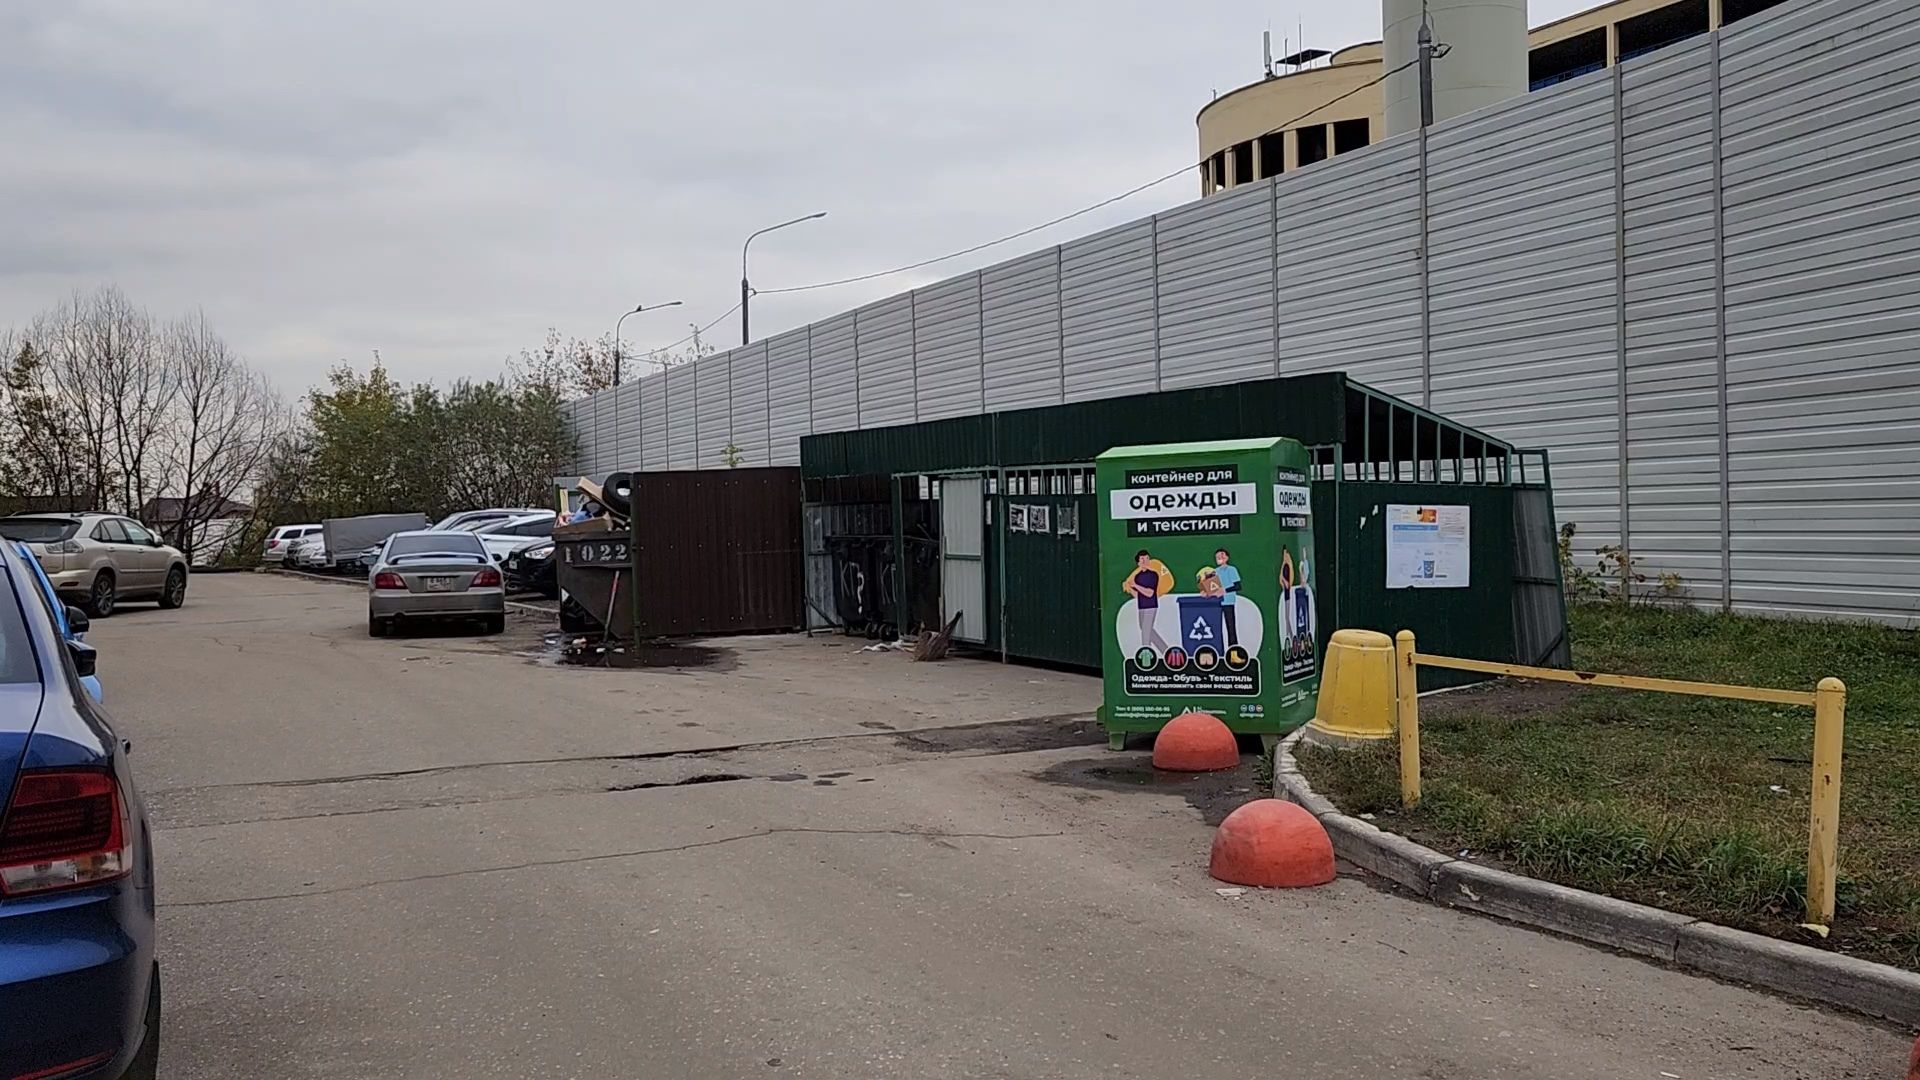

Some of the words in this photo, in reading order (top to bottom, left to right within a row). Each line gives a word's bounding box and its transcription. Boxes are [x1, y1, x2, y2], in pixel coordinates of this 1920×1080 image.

[1131, 471, 1204, 484] контейнер
[1206, 469, 1233, 481] для
[1129, 491, 1237, 511] одежды
[1137, 521, 1147, 532] и
[1153, 517, 1230, 532] текстиля
[1131, 674, 1168, 682] Одежда
[1173, 673, 1202, 683] Обувь
[1209, 674, 1253, 682] Текстиль
